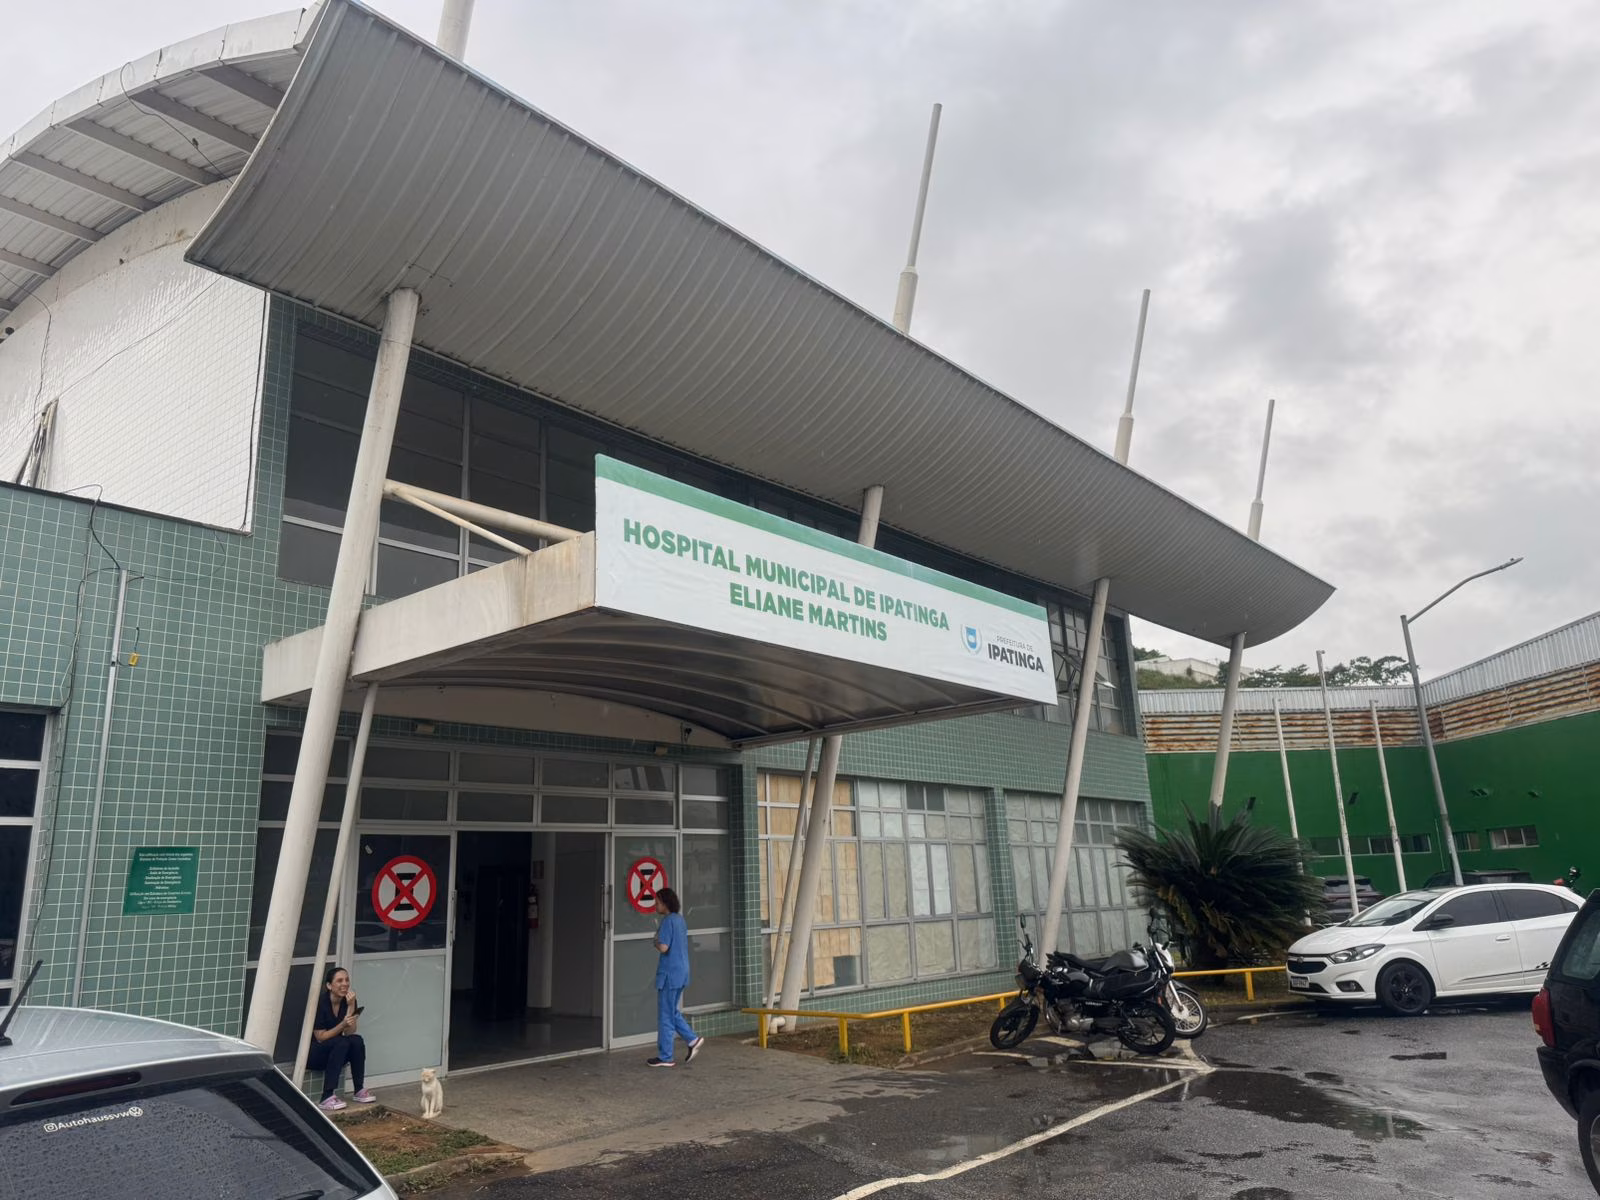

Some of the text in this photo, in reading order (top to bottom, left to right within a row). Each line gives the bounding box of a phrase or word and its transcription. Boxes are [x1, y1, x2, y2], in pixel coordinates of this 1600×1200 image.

[623, 518, 950, 631] HOSPITAL MUNICIPAL DE IPATINGA
[729, 582, 888, 641] ELIANE MARTINS
[987, 642, 1045, 673] IPATINGA
[996, 635, 1034, 652] PREFEITURA DE
[58, 1110, 130, 1130] Autohaussvw
